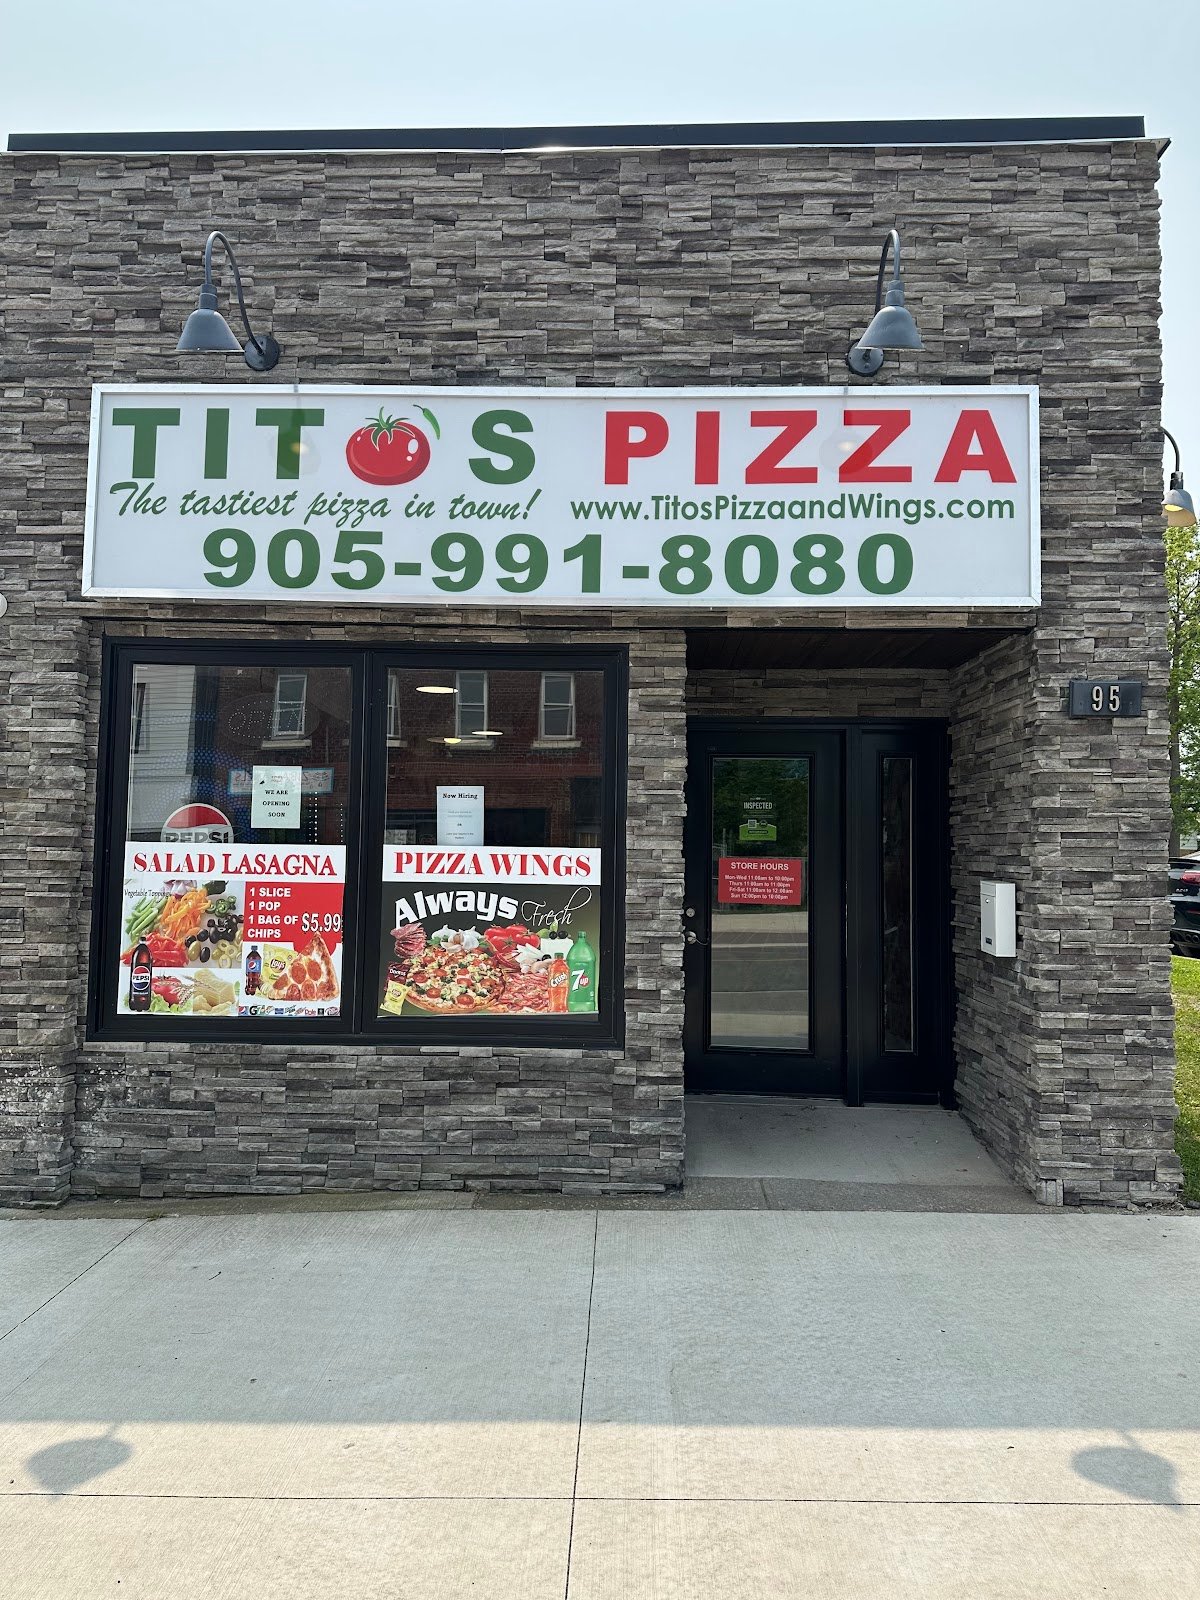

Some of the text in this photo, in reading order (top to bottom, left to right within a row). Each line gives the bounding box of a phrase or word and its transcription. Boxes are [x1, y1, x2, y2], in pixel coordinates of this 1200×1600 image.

[603, 408, 1017, 486] PIZZA
[109, 480, 543, 529] The tastiest pizza in town!
[570, 493, 1016, 525] www.TitosPizzaandWings.com
[202, 527, 914, 596] 905-991-8080
[1091, 685, 1121, 713] 95
[458, 792, 478, 800] Hiring
[743, 801, 773, 810] INSPECTED
[133, 851, 338, 877] SALAD LASAGNA
[393, 851, 592, 878] PIZZA WINGS
[730, 861, 789, 871] STORE HOURS
[124, 888, 147, 898] Vegetable
[249, 887, 292, 898] 1 SLICE
[249, 901, 281, 911] 1 POP
[394, 886, 592, 929] Always Fresh
[248, 914, 299, 926] 1 BAG OF
[301, 911, 341, 933] $5.99
[247, 928, 282, 938] CHIPS
